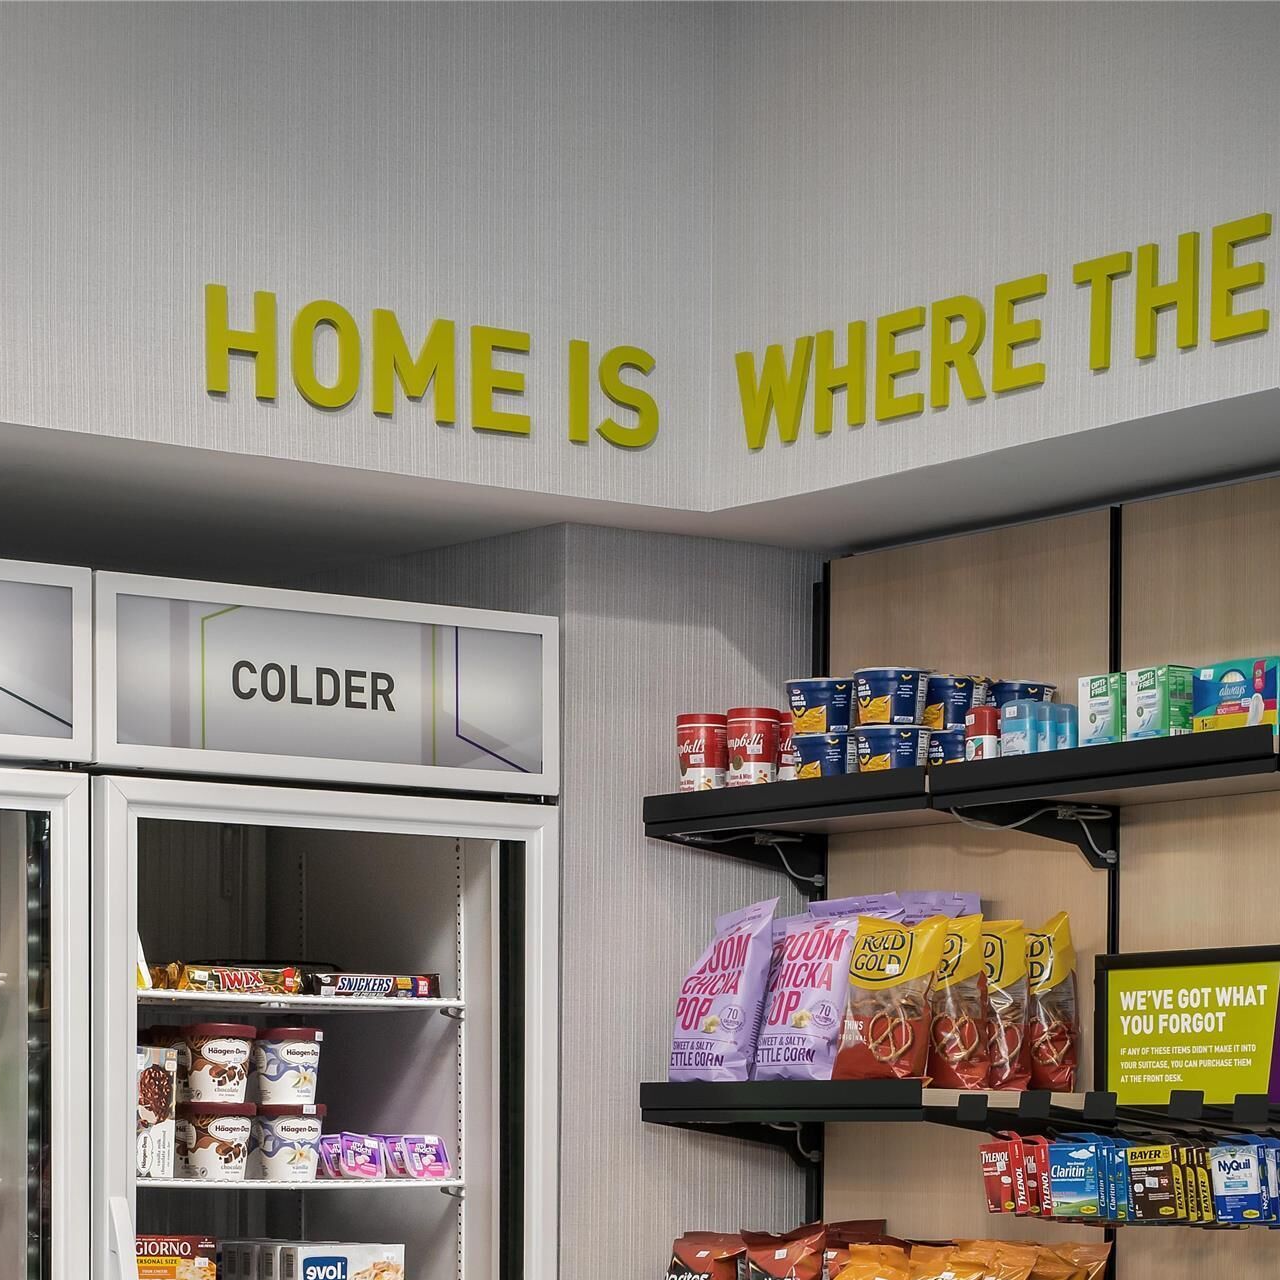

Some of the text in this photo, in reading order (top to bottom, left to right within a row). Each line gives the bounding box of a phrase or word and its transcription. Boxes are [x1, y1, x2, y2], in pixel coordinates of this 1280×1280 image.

[735, 273, 1047, 451] WHERE
[1073, 212, 1272, 372] THE
[205, 283, 660, 448] HOME IS
[231, 660, 397, 712] COLDER
[214, 969, 264, 990] TWIX
[337, 976, 394, 992] SNICKERS
[1120, 984, 1268, 1011] WE'VE GOT WHAT
[676, 997, 714, 1031] POP
[844, 1019, 864, 1031] THINS
[1120, 1012, 1226, 1035] YOU FORGOT
[781, 1036, 806, 1046] SALTY
[783, 1048, 816, 1063] CORN
[1127, 1047, 1140, 1055] ANY
[1141, 1047, 1150, 1055] OF
[1151, 1046, 1171, 1055] THESE
[1171, 1046, 1191, 1054] ITEMS
[1214, 1045, 1232, 1053] MAKE
[1233, 1044, 1240, 1053] IT
[1241, 1044, 1256, 1052] INTO
[1120, 1061, 1137, 1069] YOUR
[1170, 1060, 1183, 1068] YOU
[1184, 1060, 1198, 1068] CAN
[1199, 1059, 1233, 1068] PURCHASE
[1234, 1058, 1251, 1067] THEM
[1120, 1075, 1130, 1083] AT
[1130, 1075, 1142, 1083] THE
[1143, 1074, 1163, 1083] FRONT
[981, 1151, 1009, 1164] TYLENOL
[1130, 1149, 1161, 1161] BAYER
[1051, 1165, 1085, 1178] Claritin
[1218, 1159, 1252, 1175] NyQuil
